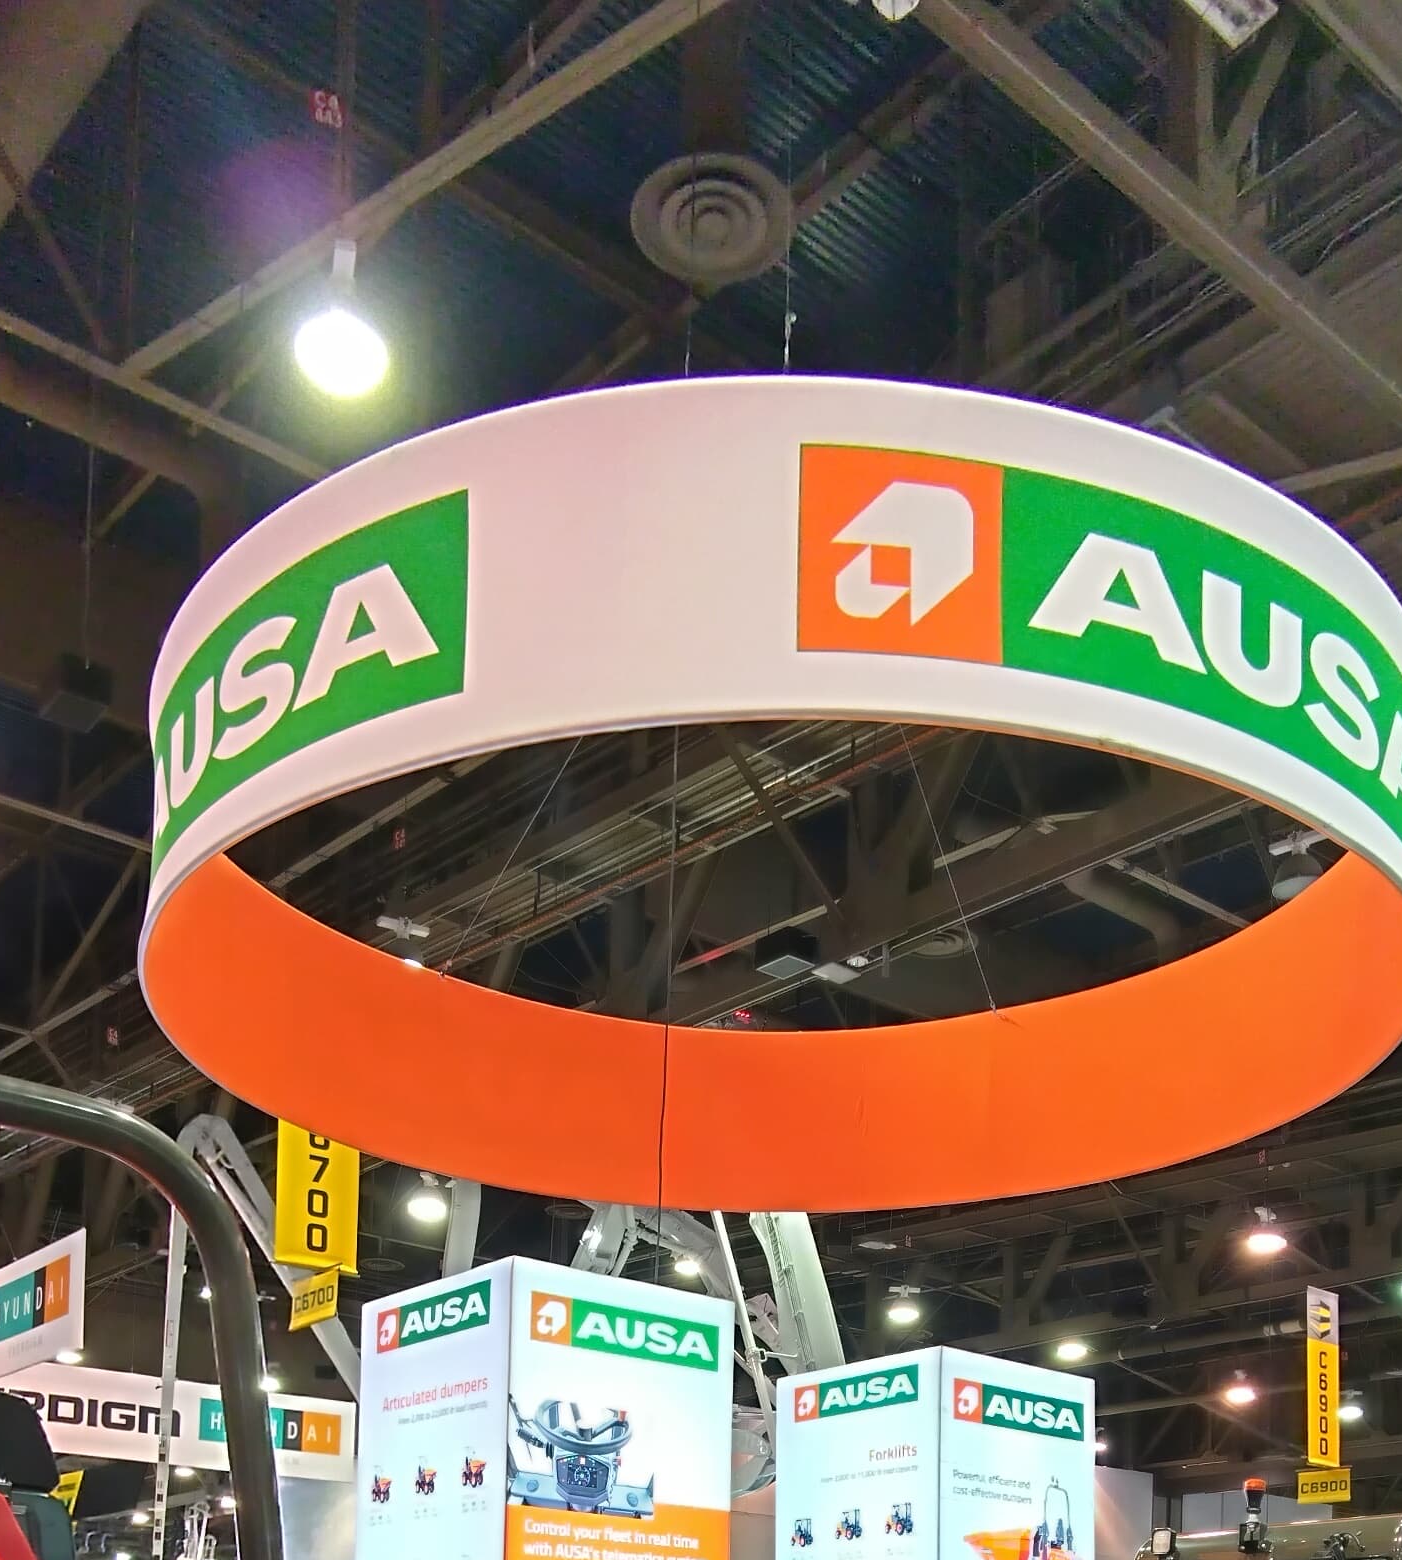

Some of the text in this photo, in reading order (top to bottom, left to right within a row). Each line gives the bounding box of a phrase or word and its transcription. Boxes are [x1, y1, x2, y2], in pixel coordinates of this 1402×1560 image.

[294, 1285, 335, 1313] C6700
[401, 1292, 487, 1338] AUSA
[576, 1312, 714, 1362] AUSA
[382, 1377, 488, 1412] Articulated dumpers
[821, 1374, 915, 1411] AUSA
[1319, 1351, 1329, 1456] C6900
[985, 1394, 1081, 1433] AUSA
[869, 1444, 917, 1462] Forklifts
[1301, 1480, 1348, 1495] C6900
[524, 1542, 552, 1557] with
[555, 1543, 600, 1560] AUSA's
[525, 1518, 699, 1549] Control your fleet in real time
